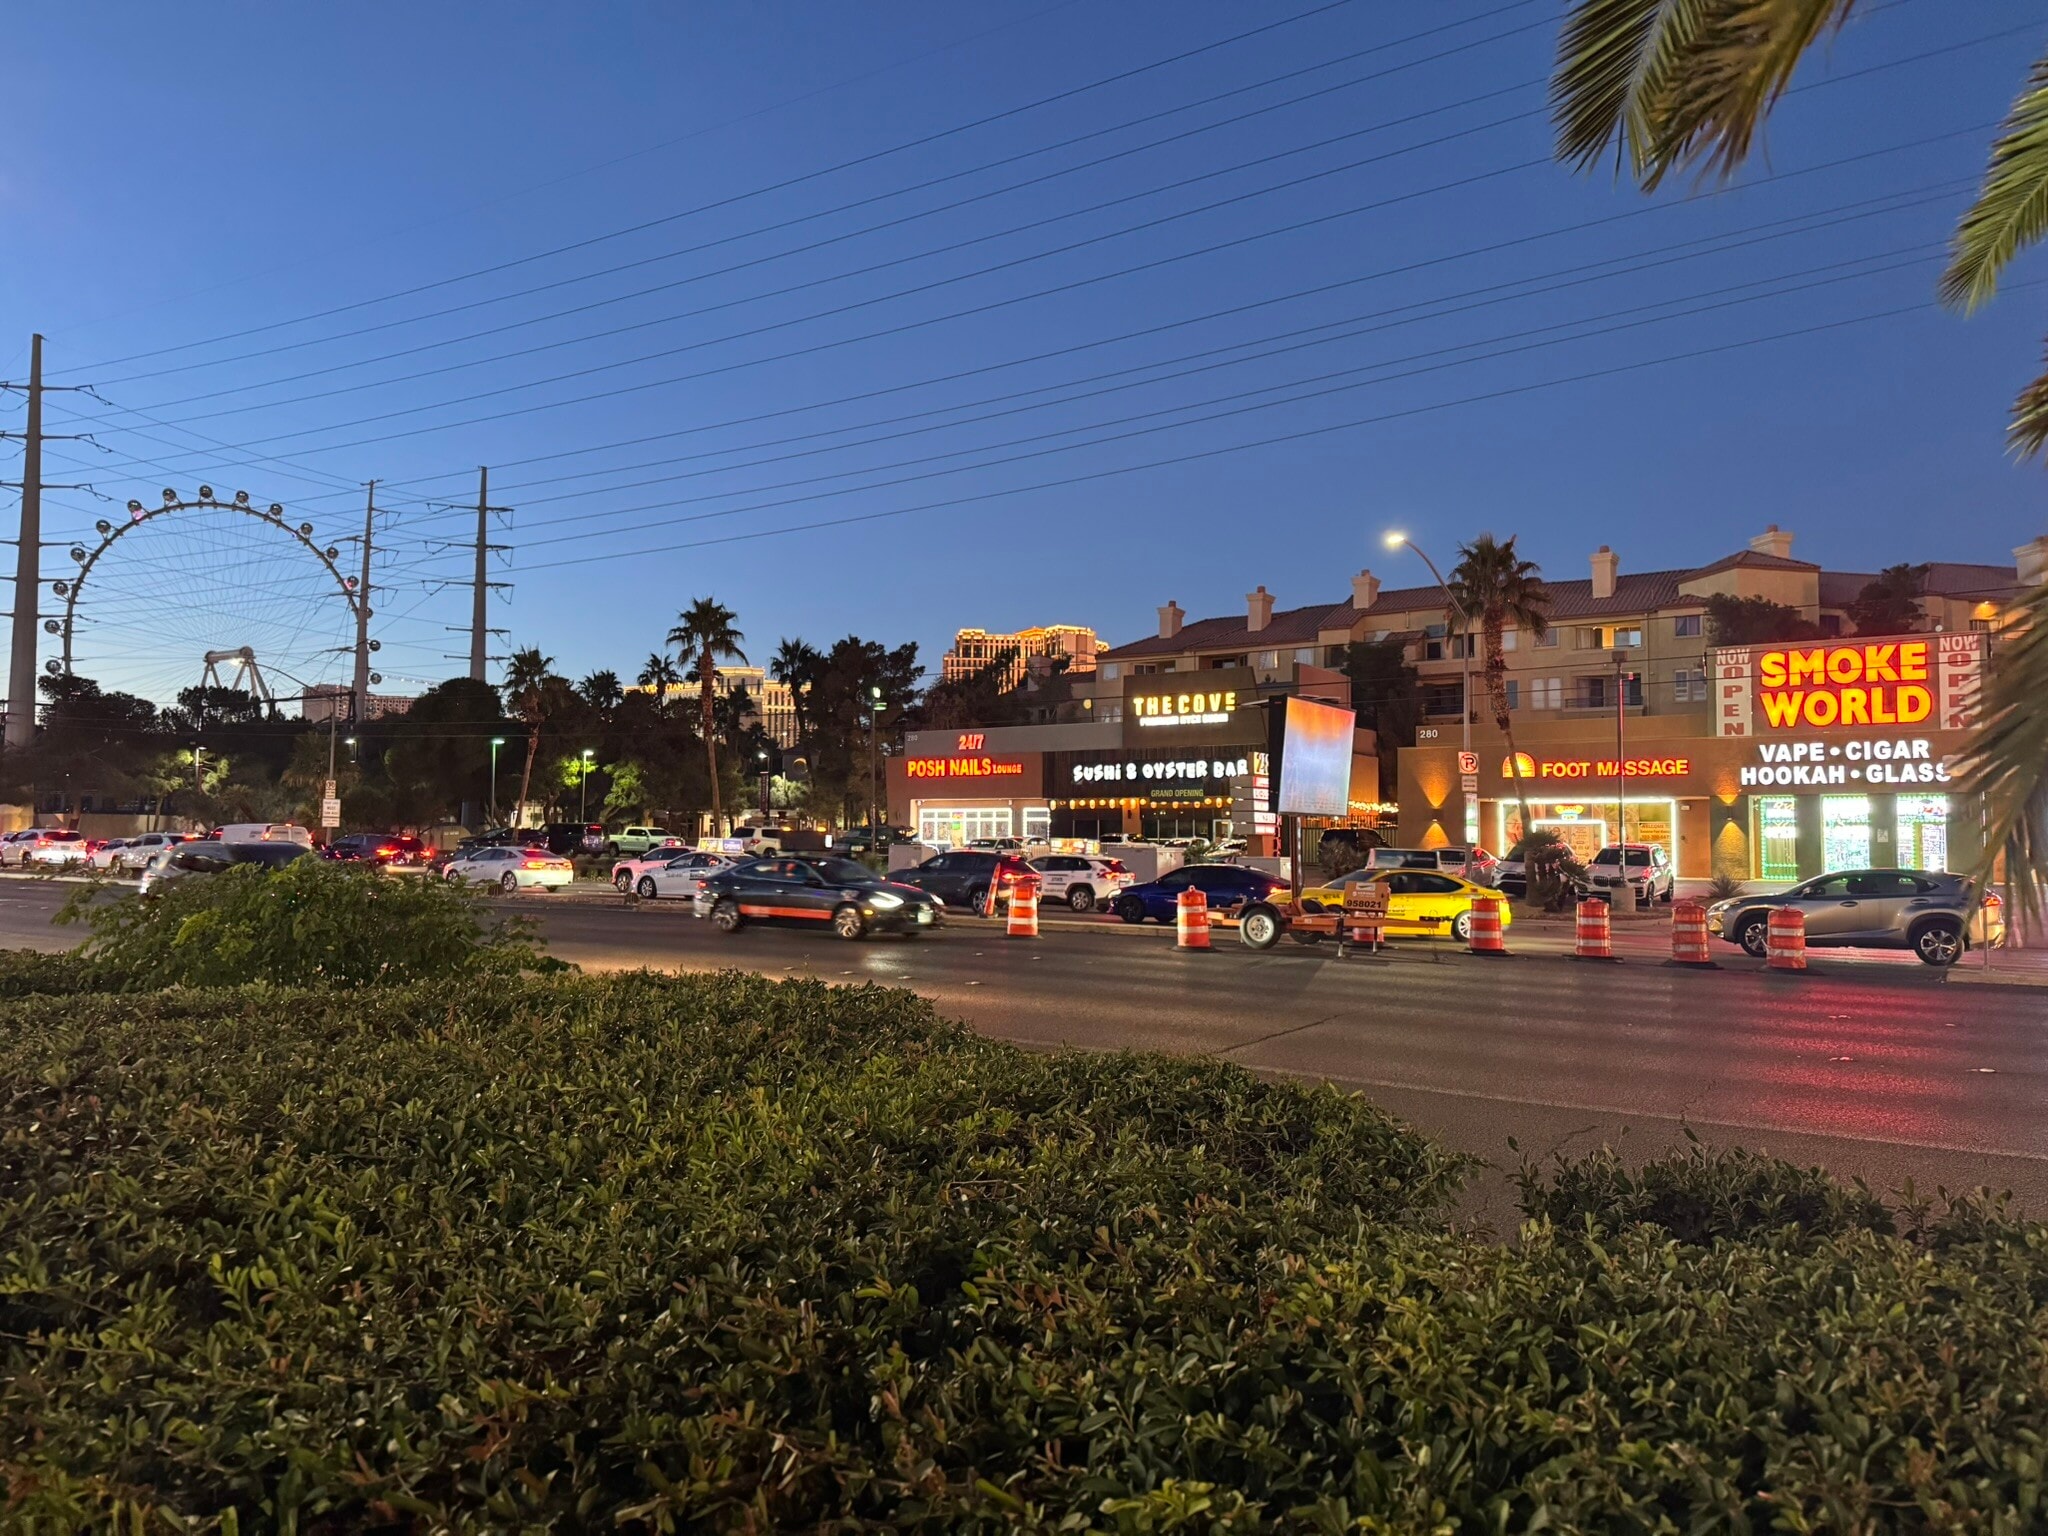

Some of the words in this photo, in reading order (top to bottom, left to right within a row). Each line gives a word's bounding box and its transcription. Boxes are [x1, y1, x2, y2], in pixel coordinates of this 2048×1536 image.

[1940, 635, 1977, 651] NOW
[1717, 648, 1750, 664] NOW
[1760, 643, 1927, 687] SMOKE
[1133, 695, 1172, 715] THE
[1178, 692, 1236, 714] COVE
[1723, 666, 1744, 735] OPEN
[1760, 685, 1931, 727] WORLD
[958, 734, 985, 750] 24/7
[1420, 729, 1438, 738] 280
[1759, 742, 1825, 762] VAPE
[1845, 740, 1929, 760] CIGAR
[907, 759, 945, 777] POSH
[949, 758, 991, 776] NAILS
[992, 763, 1022, 774] LOUNGE
[1126, 763, 1137, 780] &
[1142, 760, 1208, 779] OYSTER
[1213, 759, 1248, 778] BAR
[1542, 762, 1591, 777] FOOT
[1597, 759, 1688, 776] MASSAGE
[1740, 765, 1845, 785] HOOKAH
[1866, 763, 1951, 783] GLASS
[1151, 789, 1173, 798] GRAND
[1174, 788, 1204, 797] OPENING
[1346, 900, 1382, 909] 958021
